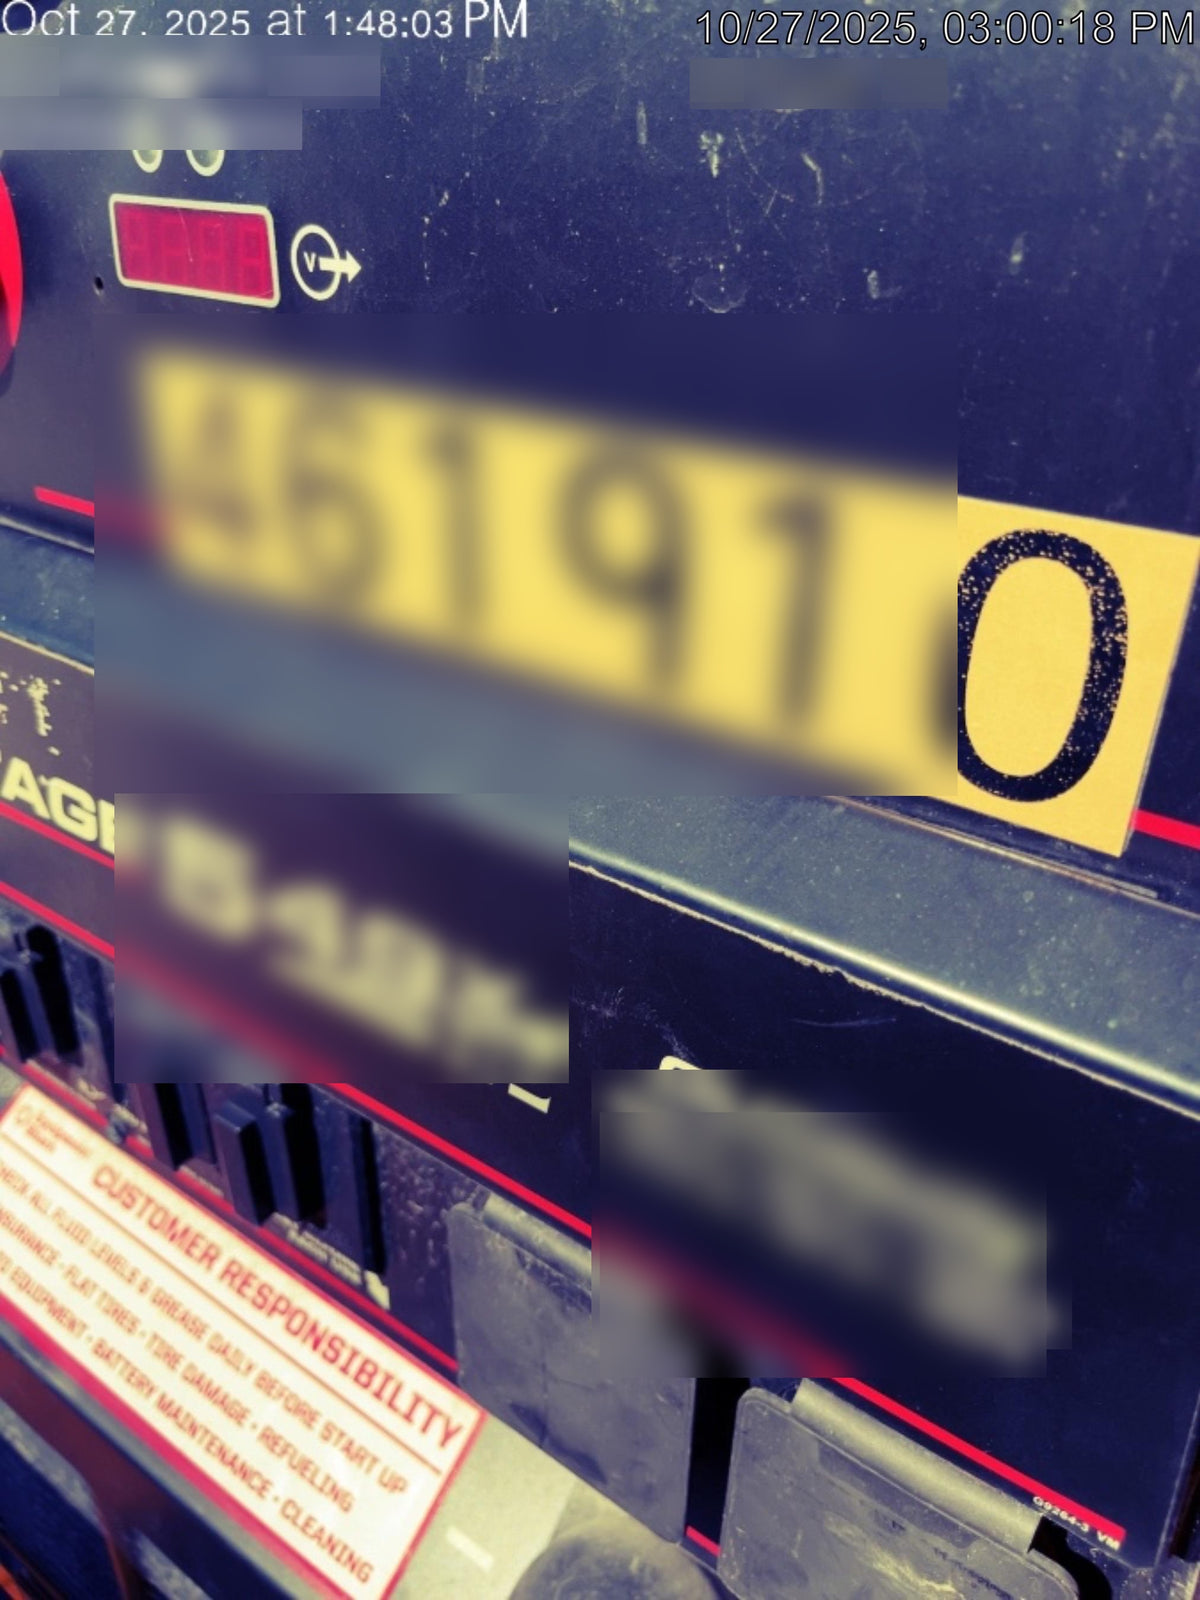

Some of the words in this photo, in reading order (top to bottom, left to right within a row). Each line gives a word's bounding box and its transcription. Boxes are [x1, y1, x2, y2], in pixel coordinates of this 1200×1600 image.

[10, 1265, 88, 1338] EQUIPMENT
[92, 1337, 157, 1399] BATTERY
[155, 1391, 274, 1499] MAINTENANCE
[279, 1498, 375, 1584] CLEANING
[64, 1264, 99, 1299] FLAT
[147, 1331, 184, 1371] TIRE
[181, 1361, 251, 1427] DAMAGE
[257, 1425, 355, 1513] REFUELING
[89, 1239, 139, 1284] LEVELS
[152, 1286, 209, 1340] GREASE
[207, 1331, 255, 1377] DAILY
[254, 1369, 321, 1430] BEFORE
[319, 1421, 380, 1475] START
[378, 1466, 409, 1493] UP
[92, 1163, 222, 1272] CUSTOMER
[219, 1257, 464, 1450] RESPONSIBILITY
